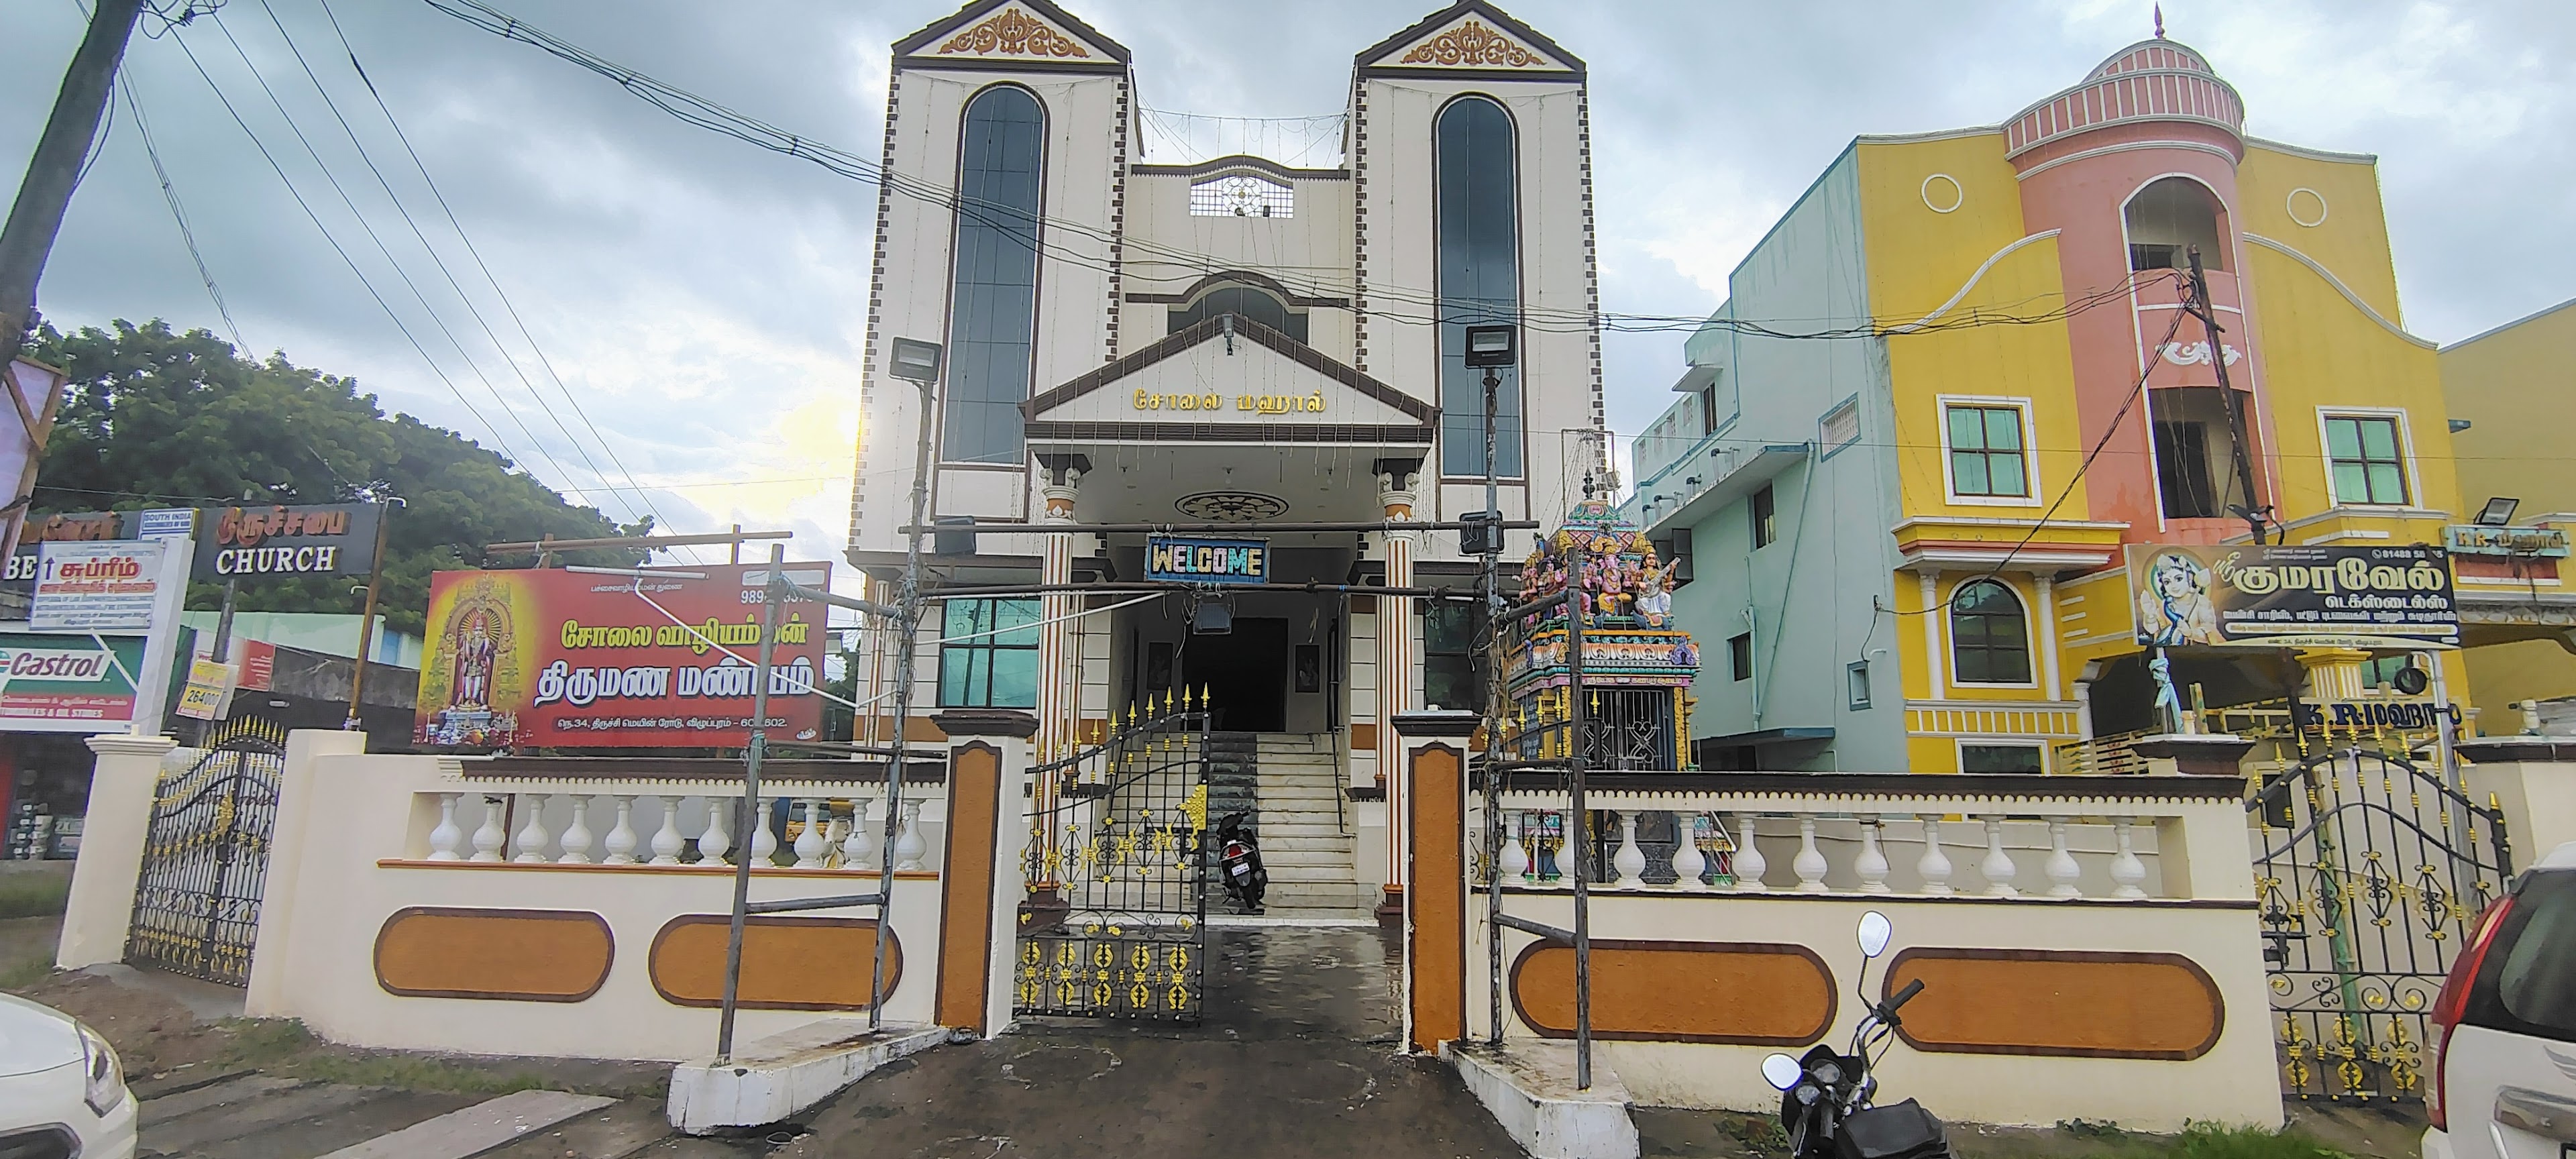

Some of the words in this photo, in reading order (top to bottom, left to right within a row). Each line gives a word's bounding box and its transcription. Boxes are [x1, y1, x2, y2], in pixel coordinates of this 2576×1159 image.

[1133, 388, 1223, 410] சோலை
[1237, 389, 1326, 416] மஹால்
[217, 505, 345, 545] திருச்சபை
[60, 557, 142, 580] சுப்ரீம்
[216, 546, 337, 575] CHURCH
[1153, 545, 1263, 575] WELCOME
[2233, 557, 2445, 594] குமரவேல்
[561, 619, 653, 649] சோலை
[656, 612, 810, 655] வாழியம்ன்
[11, 652, 105, 677] Castrol
[533, 659, 672, 708] திருமண
[591, 718, 621, 730] திருச்சி
[622, 718, 657, 728] மெயின்
[686, 717, 732, 730] விழுப்புரம்
